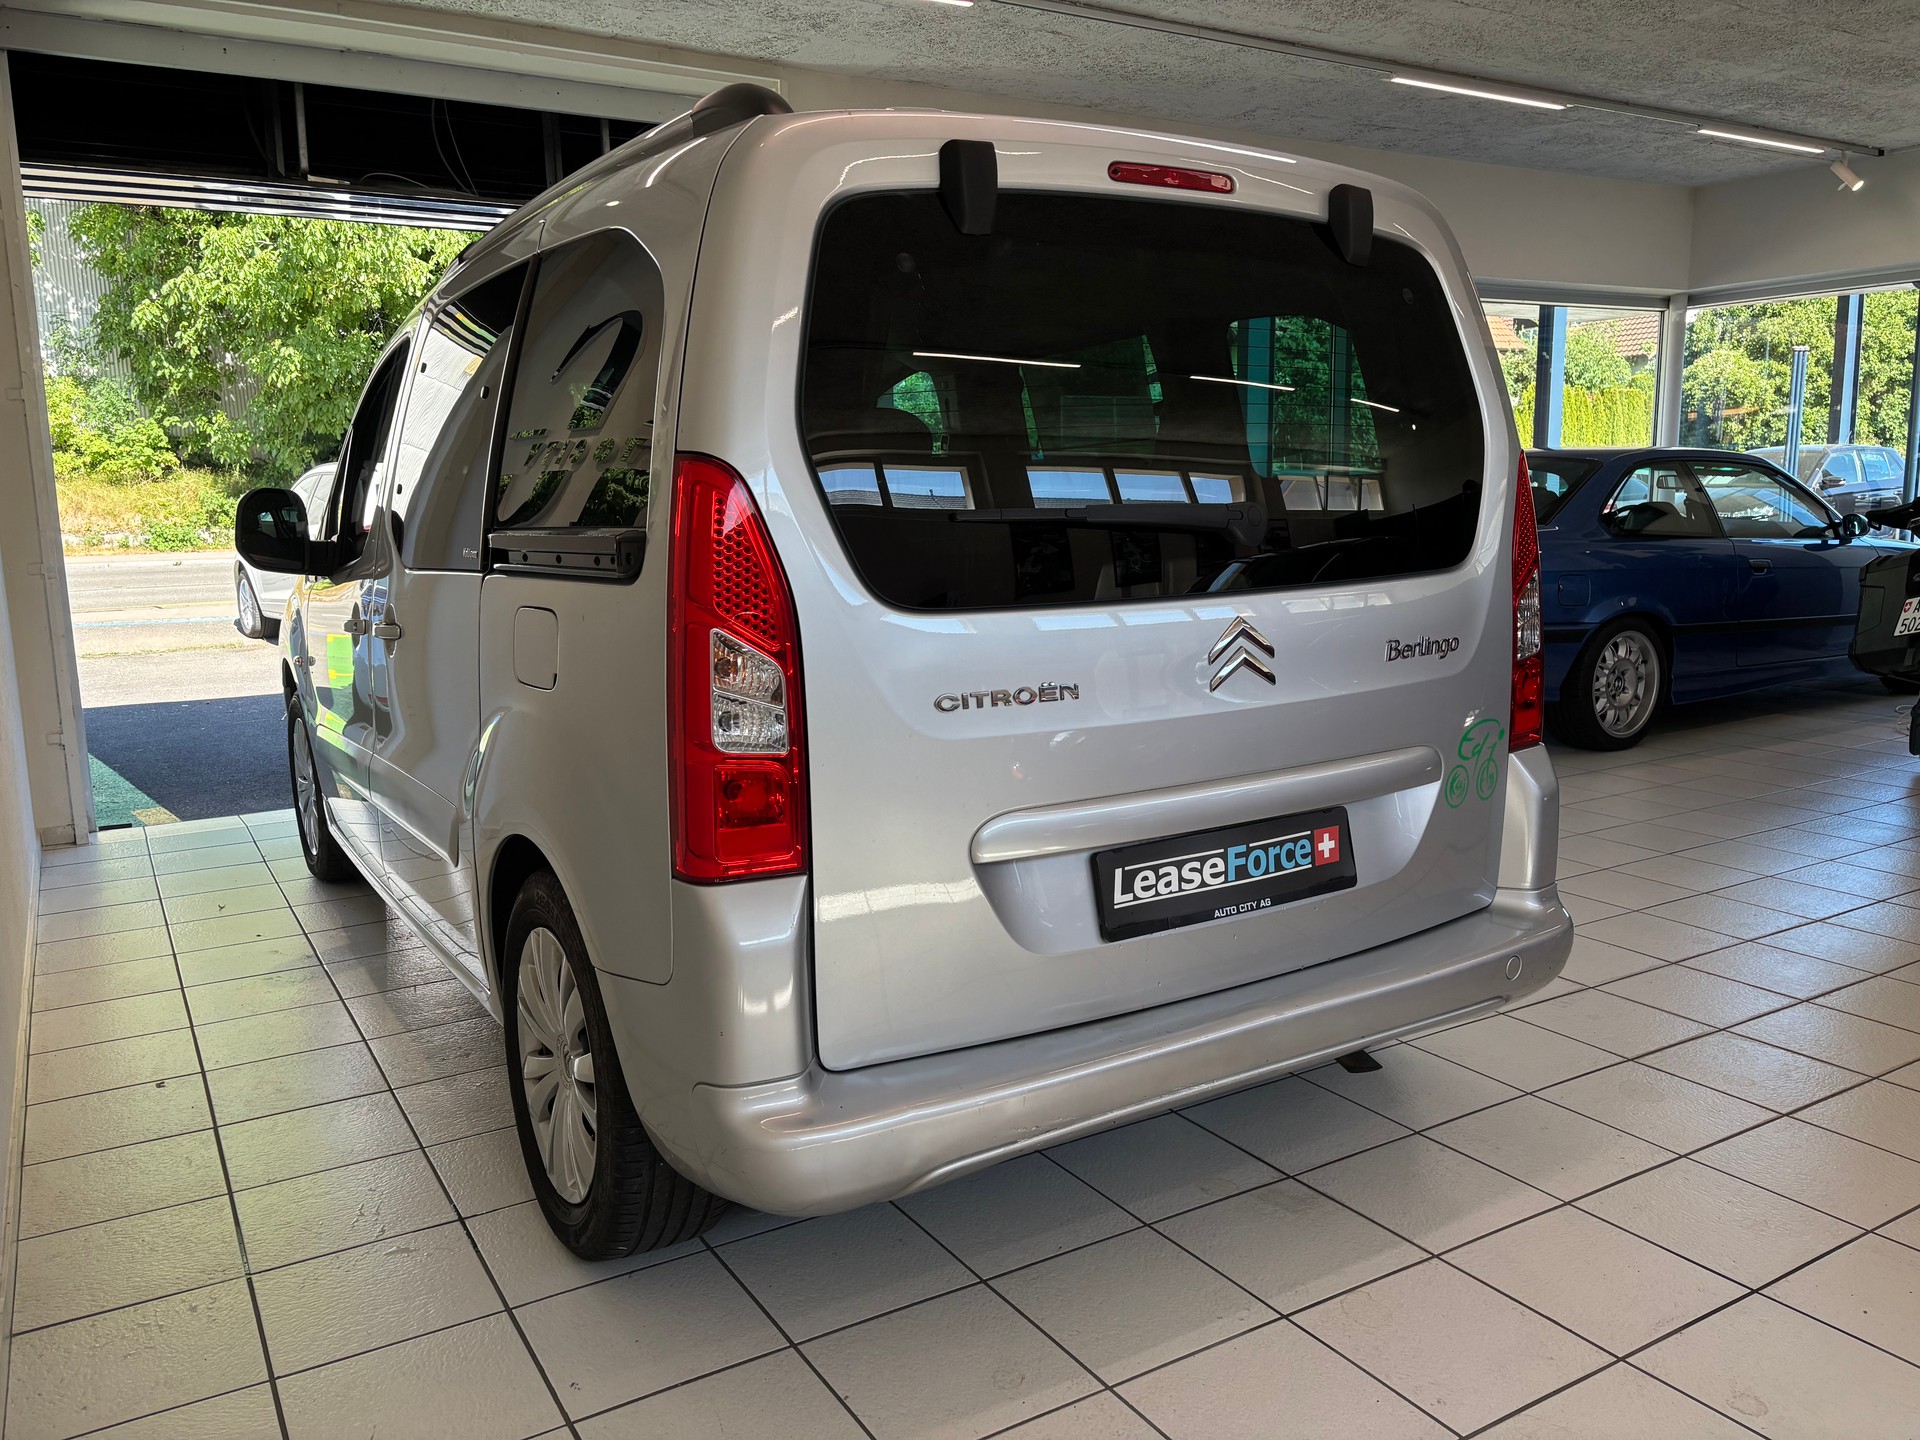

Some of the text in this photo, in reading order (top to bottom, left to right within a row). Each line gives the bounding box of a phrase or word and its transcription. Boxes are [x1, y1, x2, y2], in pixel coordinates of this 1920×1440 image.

[1384, 635, 1460, 662] Berlingo
[933, 681, 1080, 713] CITROËN
[1113, 838, 1312, 904] LeaseForce
[1214, 898, 1272, 918] AUTO CITY AG
